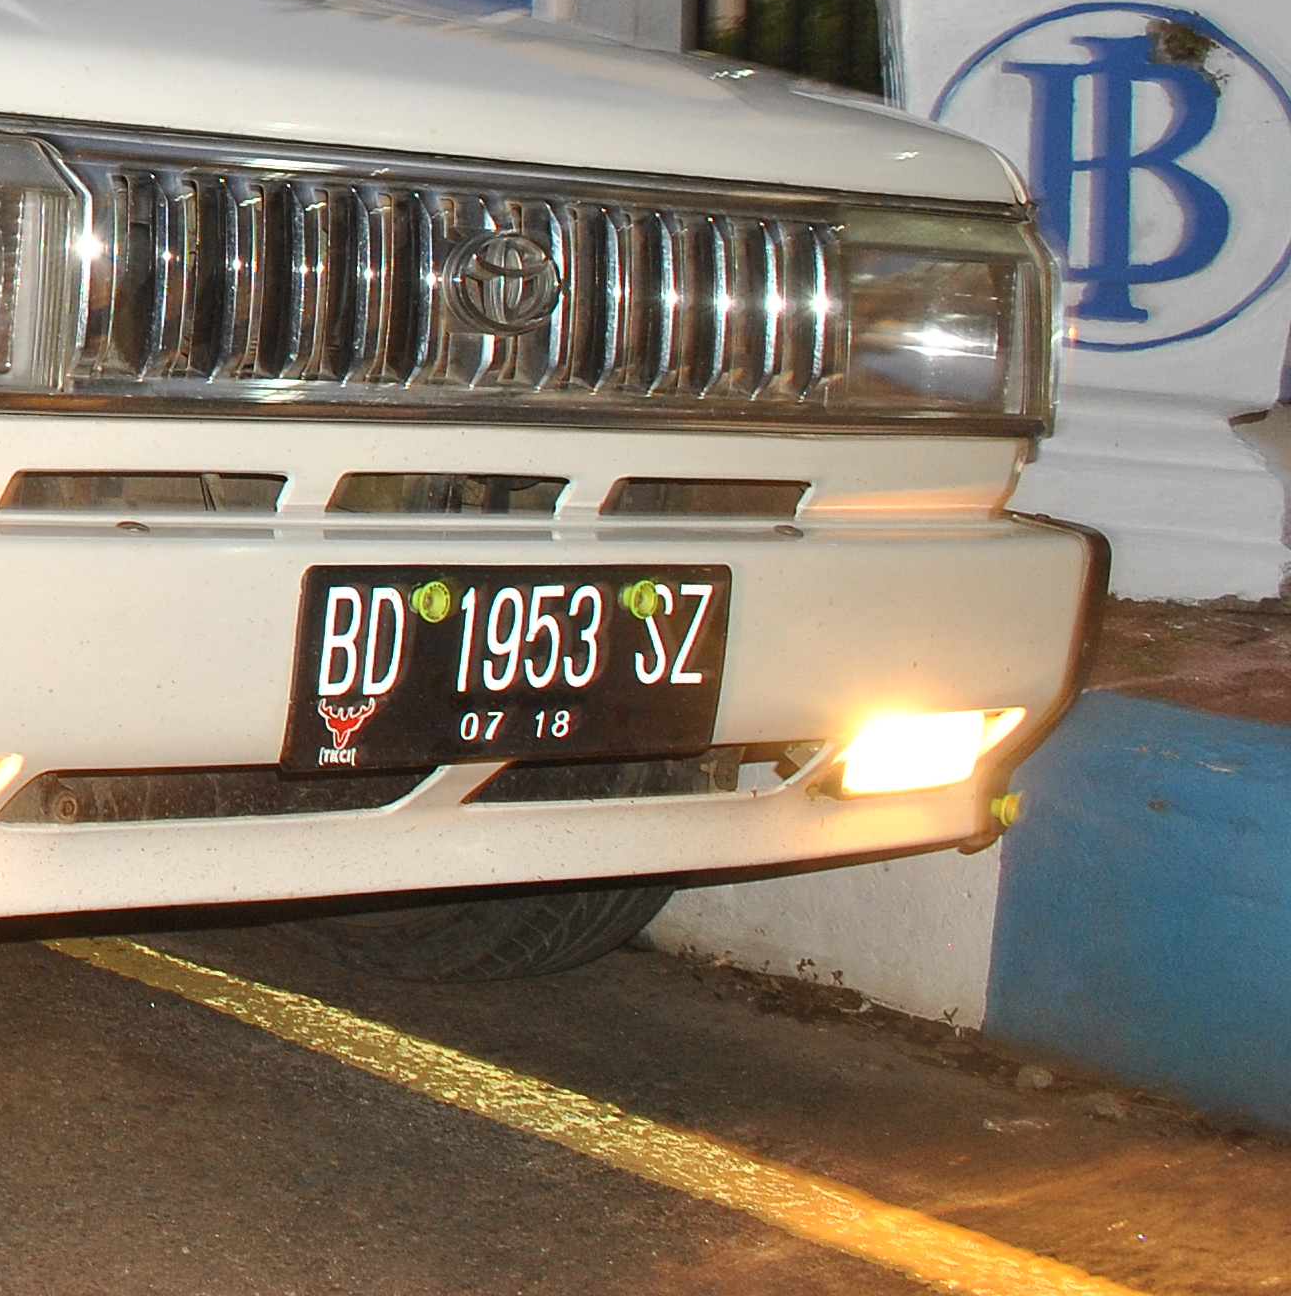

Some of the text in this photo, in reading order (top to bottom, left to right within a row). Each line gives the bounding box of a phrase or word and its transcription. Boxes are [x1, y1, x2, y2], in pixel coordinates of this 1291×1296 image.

[318, 583, 714, 696] BD 1953 SZ
[460, 710, 571, 741] 07 18
